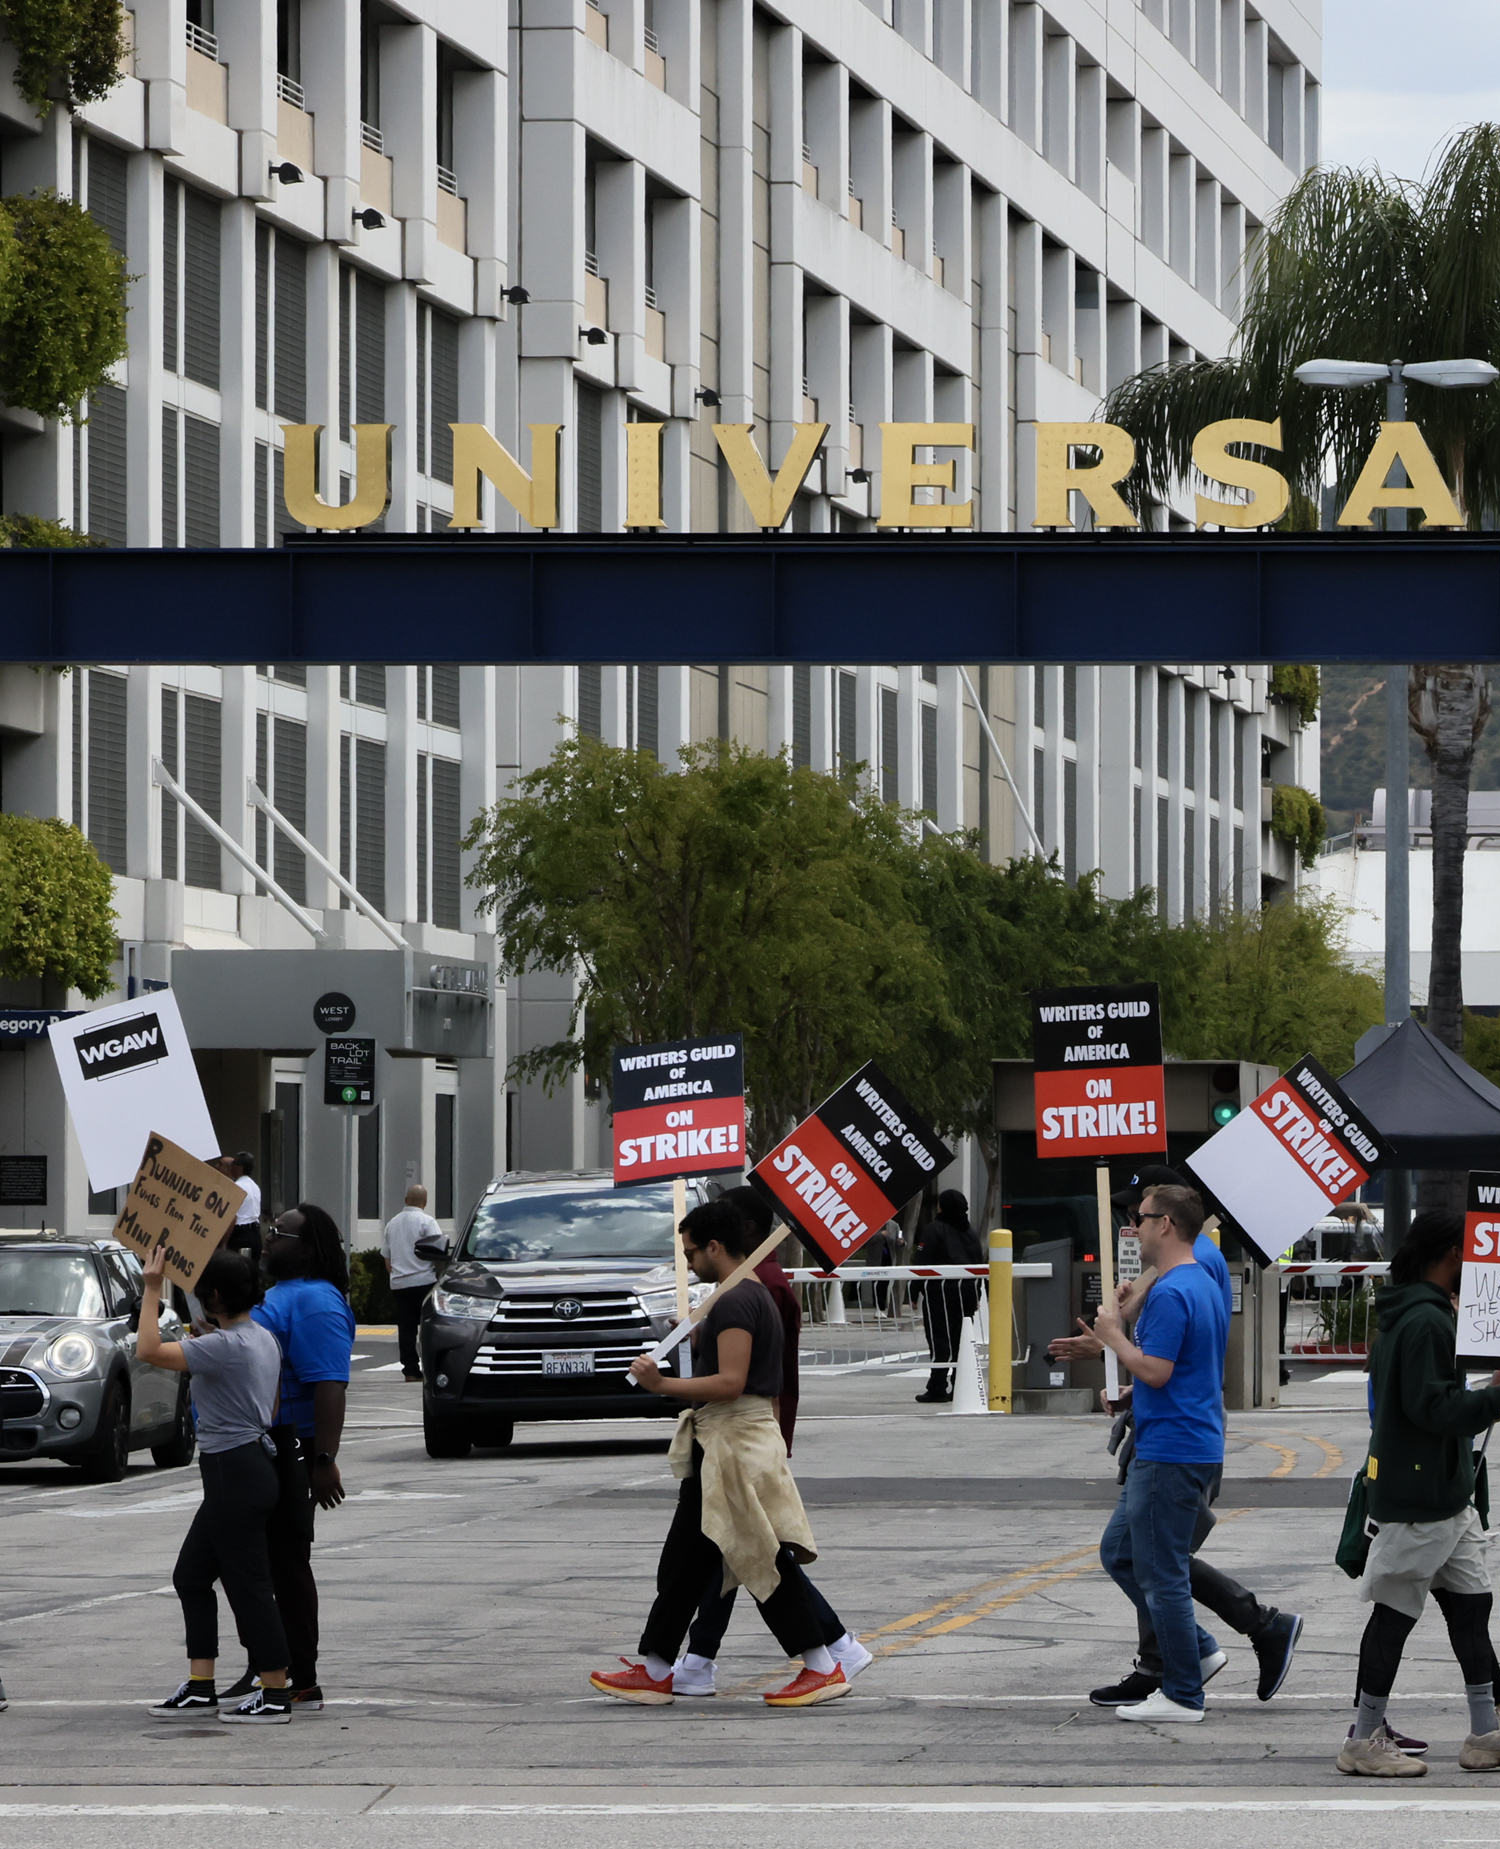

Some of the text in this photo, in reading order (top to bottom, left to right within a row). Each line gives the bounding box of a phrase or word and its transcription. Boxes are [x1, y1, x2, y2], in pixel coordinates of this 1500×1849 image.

[320, 1006, 349, 1014] WEST
[1039, 1001, 1150, 1023] WRITERS GUILD
[80, 1027, 158, 1064] WGAW
[1087, 1025, 1103, 1039] OF
[620, 1044, 736, 1072] WRITERS GUILD
[1064, 1043, 1130, 1062] AMERICA
[669, 1067, 686, 1080] OF
[643, 1080, 713, 1101] AMERICA
[1085, 1078, 1112, 1099] ON
[666, 1109, 694, 1128] ON
[855, 1078, 936, 1172] WRITERS GUILD
[1042, 1100, 1157, 1140] STRIKE!
[1296, 1067, 1379, 1162] WRITERS GUILD
[1318, 1118, 1334, 1135] ON
[619, 1124, 739, 1167] STRIKE!
[840, 1123, 893, 1182] AMERICA
[874, 1130, 891, 1147] OF
[1260, 1091, 1357, 1195] STRIKE!
[141, 1138, 230, 1218] RUNNING ON
[830, 1162, 858, 1191] ON
[134, 1176, 209, 1238] FUMES FROM THE
[772, 1144, 869, 1249] STRIKE!
[118, 1207, 152, 1247] MINI
[1465, 1302, 1499, 1318] THE
